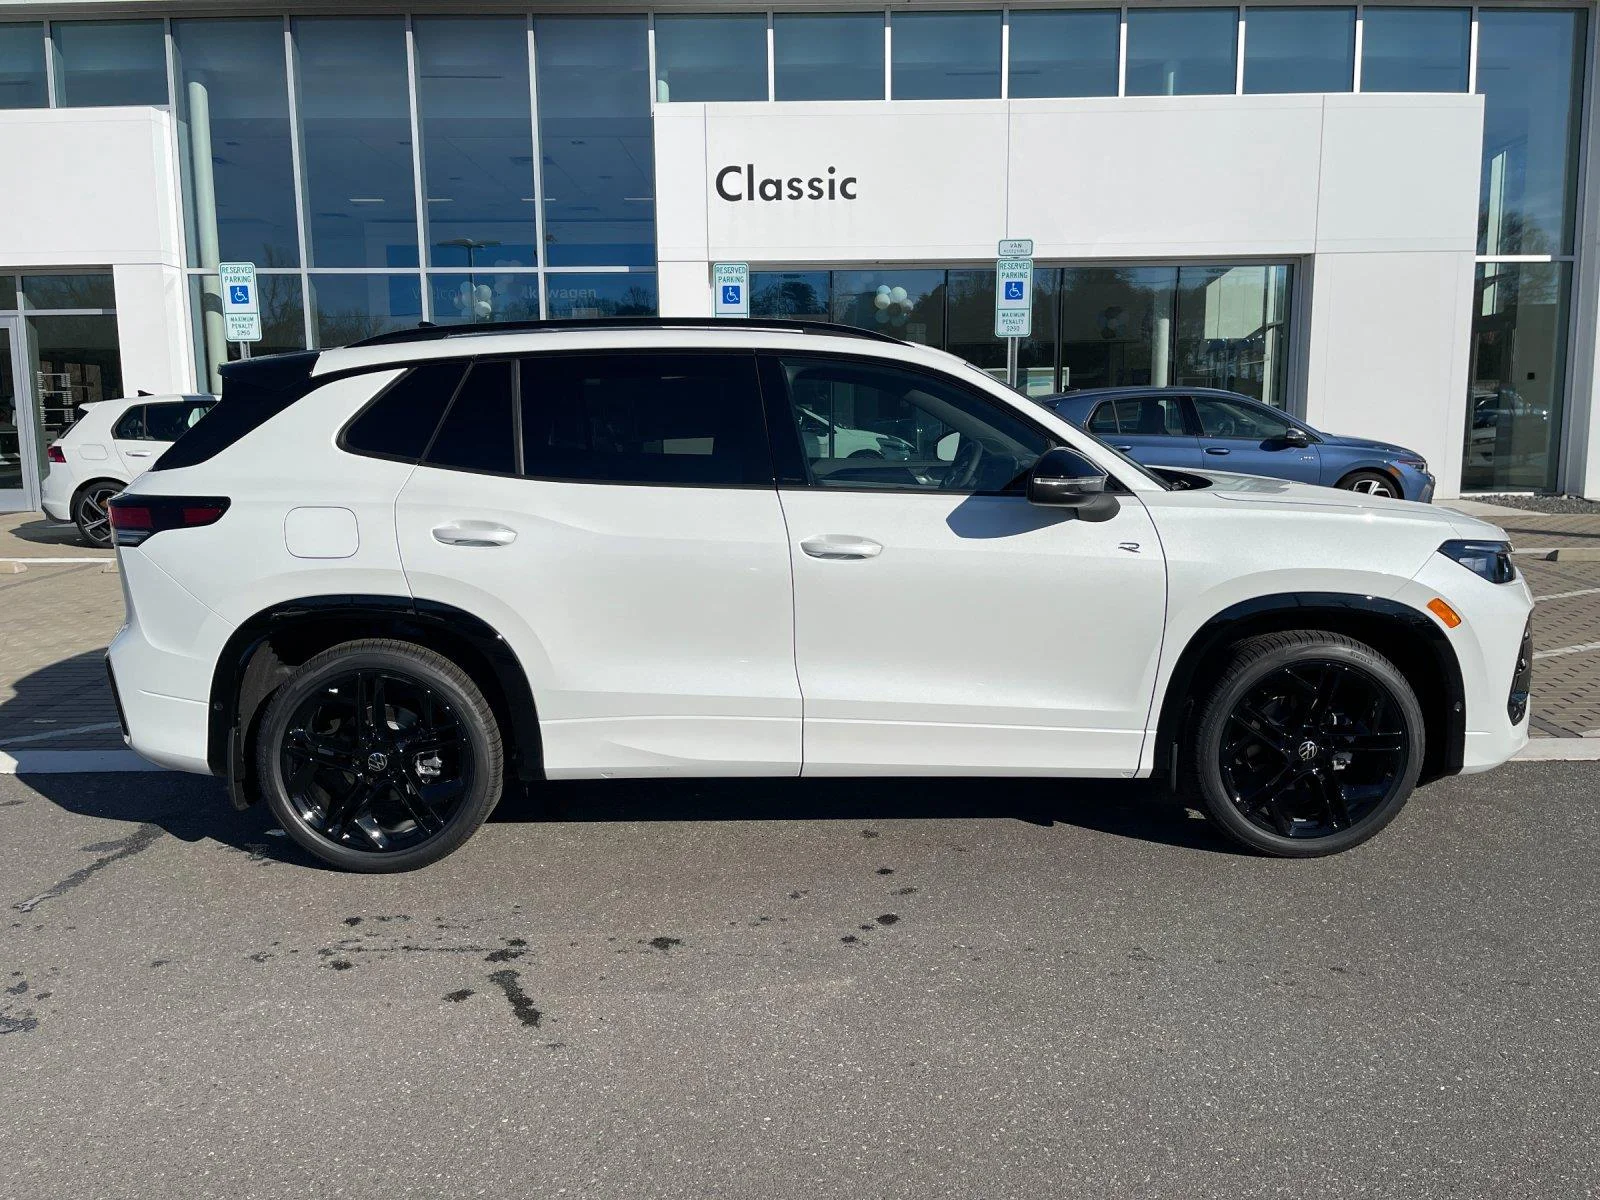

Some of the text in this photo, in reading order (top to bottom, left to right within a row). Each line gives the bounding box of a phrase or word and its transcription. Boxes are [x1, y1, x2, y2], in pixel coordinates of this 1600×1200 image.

[715, 163, 857, 202] Classic
[221, 266, 253, 274] RESERVED
[716, 266, 746, 274] RESERVED
[1000, 262, 1030, 270] RESERVED
[1001, 271, 1028, 279] PARKING
[224, 275, 252, 284] PARKING
[718, 276, 745, 284] PARKING
